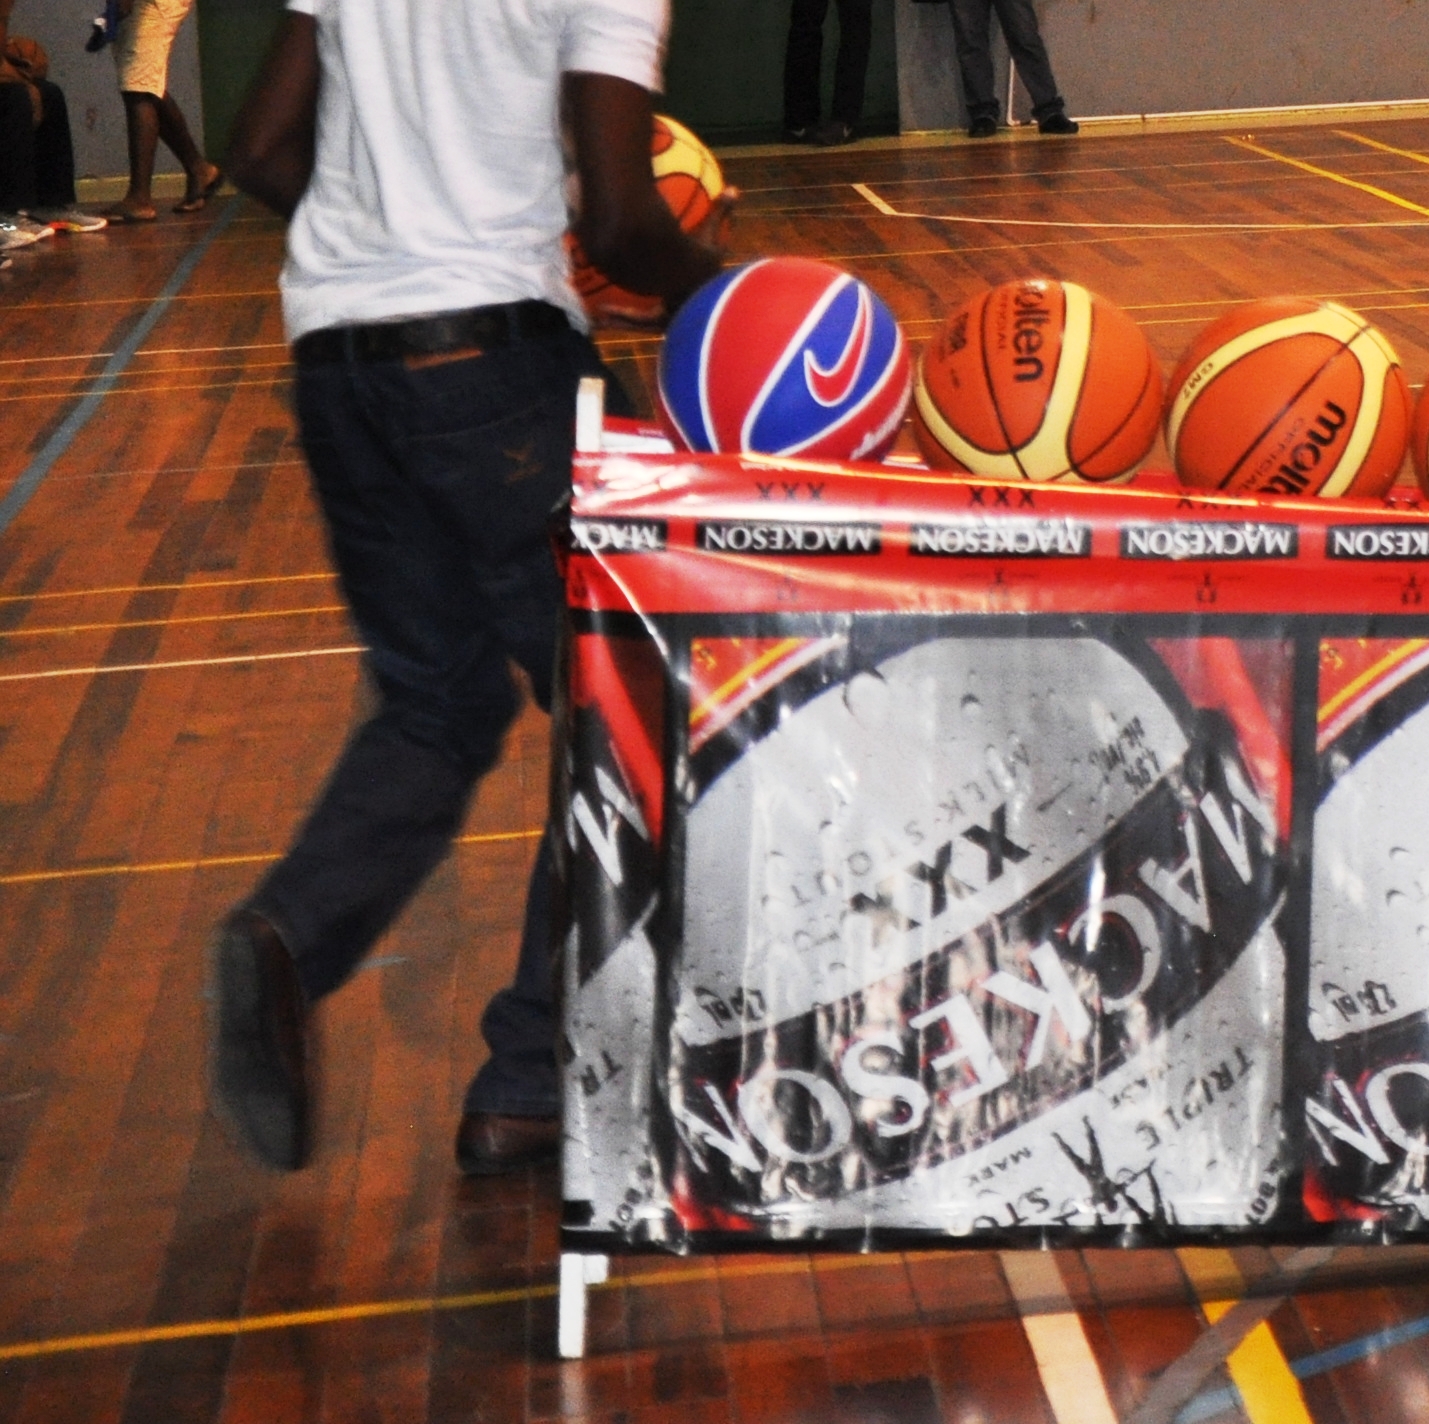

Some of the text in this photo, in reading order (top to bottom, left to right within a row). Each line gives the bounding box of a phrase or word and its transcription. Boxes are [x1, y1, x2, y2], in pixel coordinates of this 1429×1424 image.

[1013, 286, 1051, 383] olten
[967, 486, 1037, 510] XXX
[703, 522, 874, 552] MACKESON
[917, 522, 1085, 554] MACKESON
[1126, 522, 1293, 556] MACKESON
[681, 754, 1278, 1173] MACKESON
